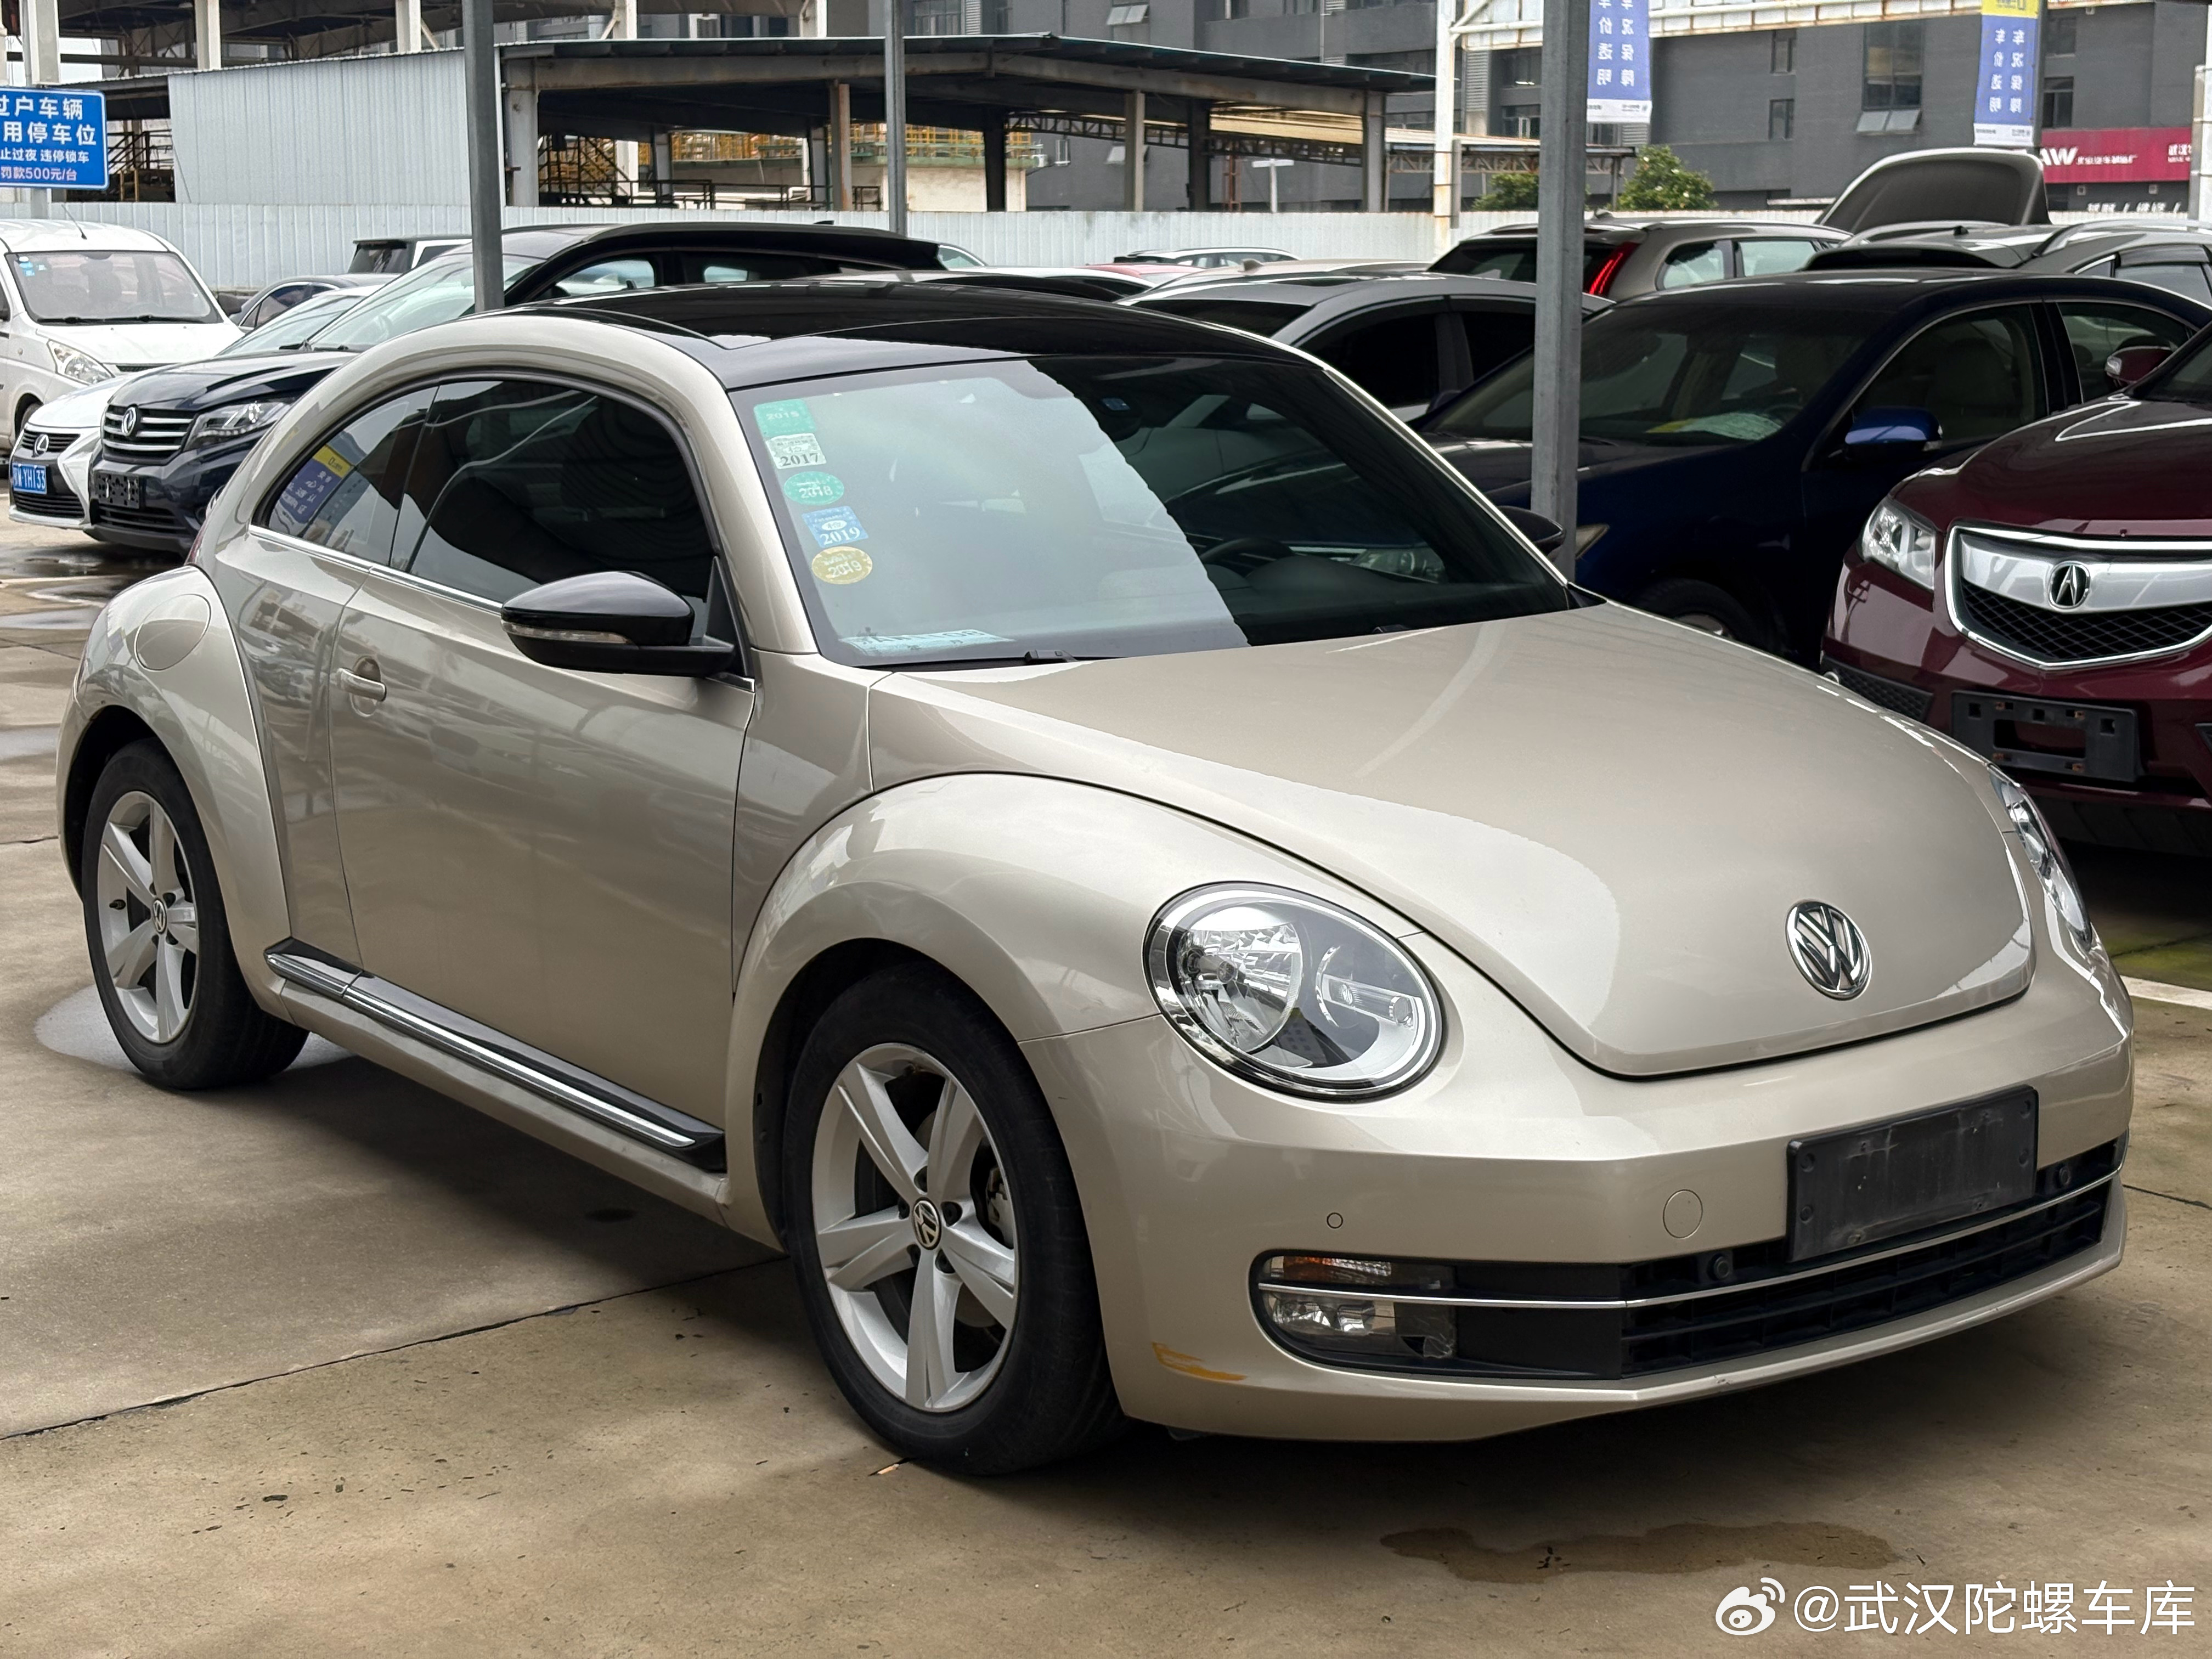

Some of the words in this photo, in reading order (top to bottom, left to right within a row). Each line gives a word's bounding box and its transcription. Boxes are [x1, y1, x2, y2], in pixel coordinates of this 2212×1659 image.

[3, 120, 97, 146] 用停车位
[40, 149, 90, 164] 违停锁车
[1, 166, 77, 182] 罚款500元/台
[780, 453, 819, 466] 2017
[798, 486, 833, 499] 2018
[820, 527, 860, 545] 2019
[827, 560, 862, 578] 2019
